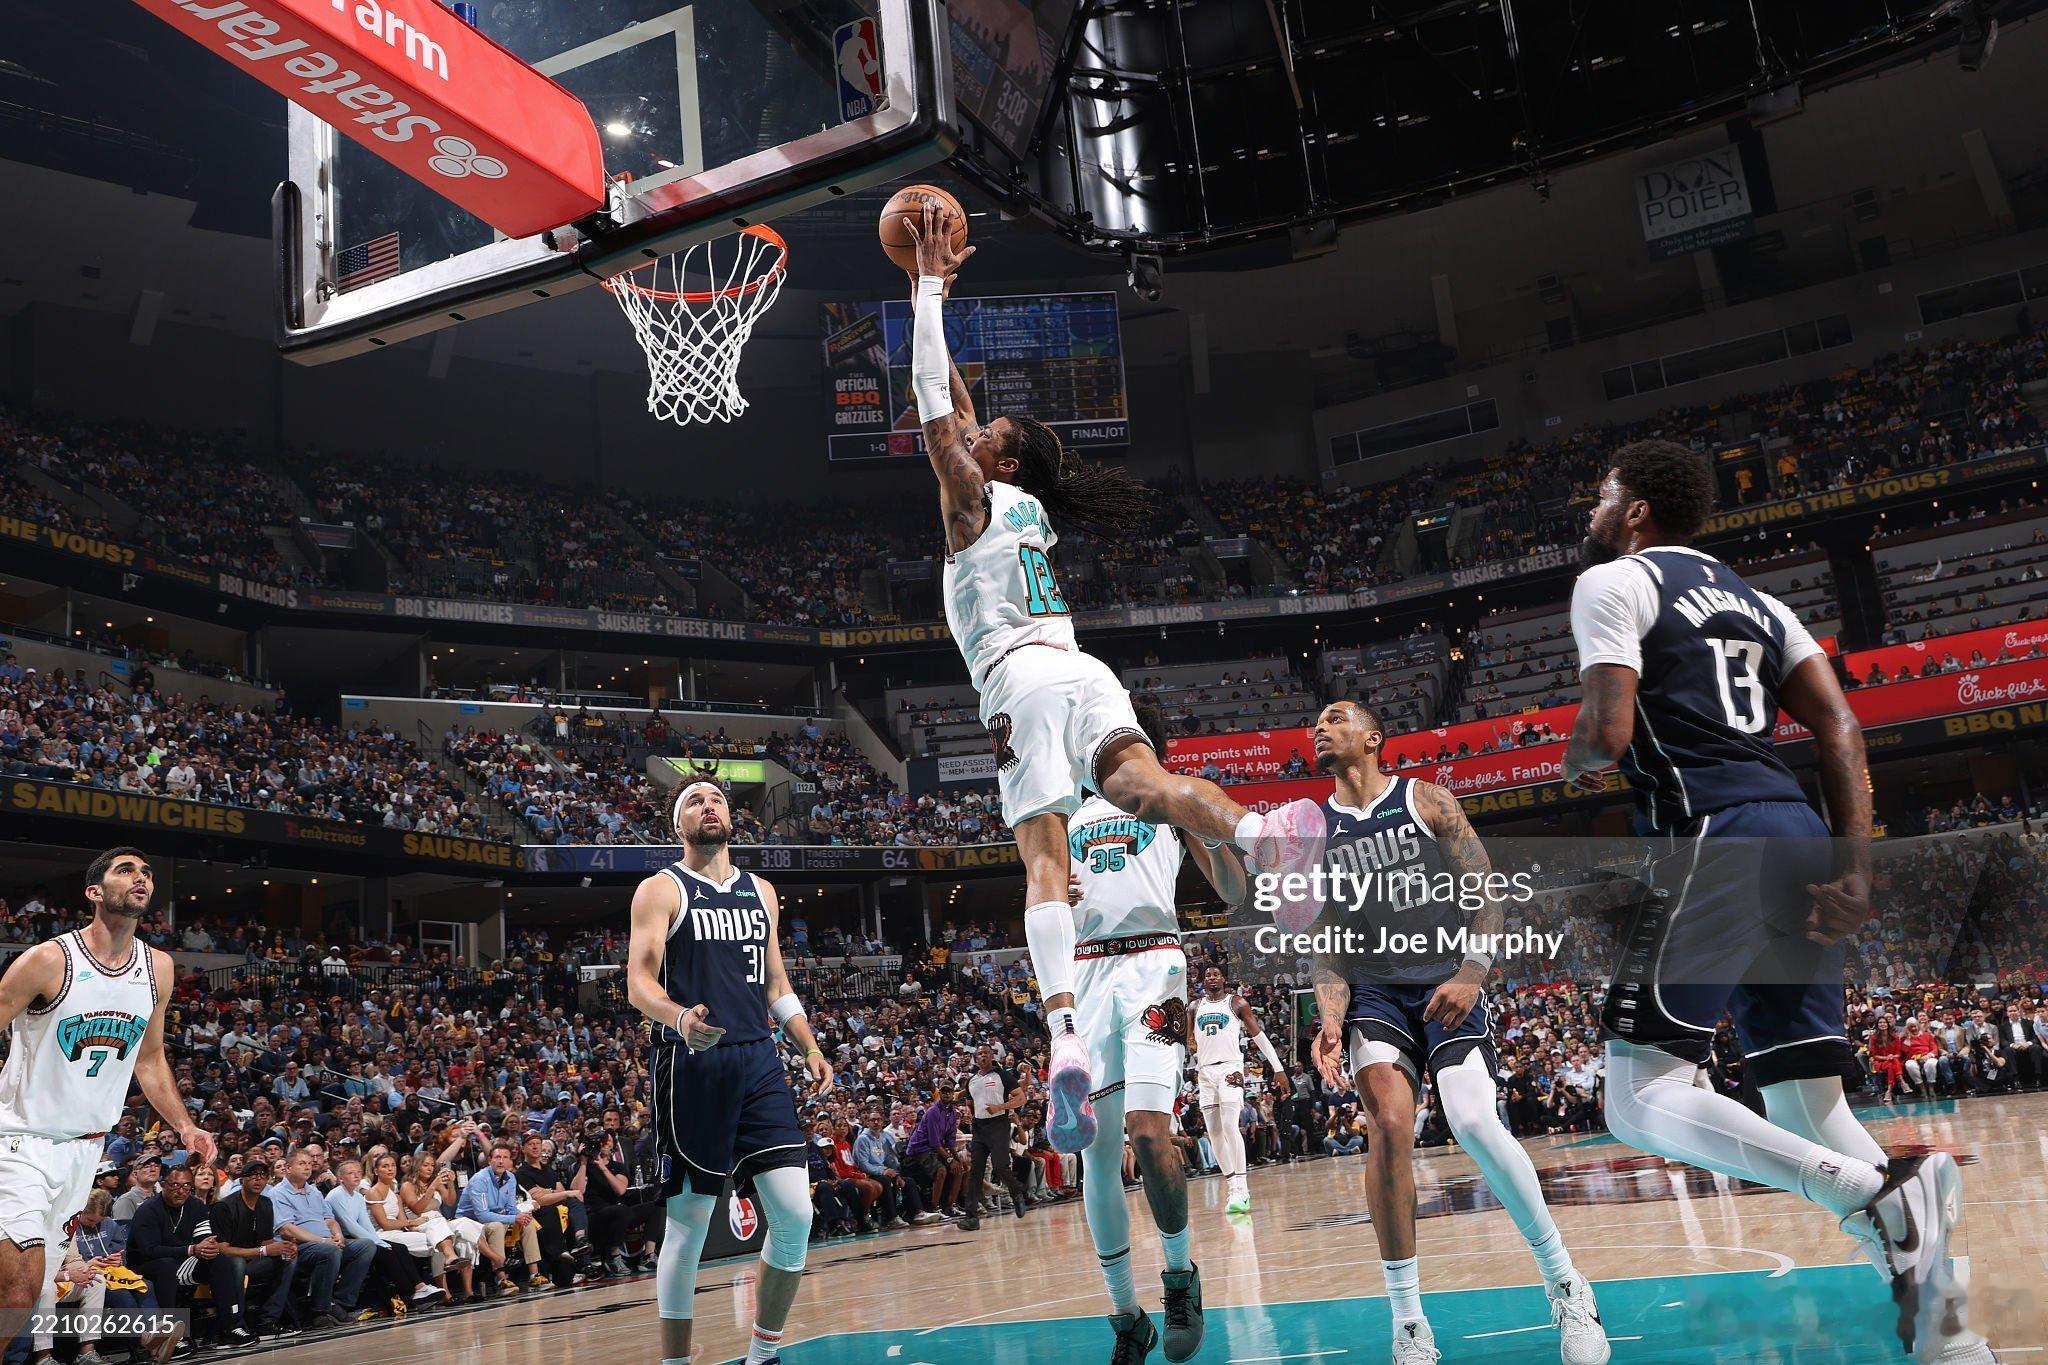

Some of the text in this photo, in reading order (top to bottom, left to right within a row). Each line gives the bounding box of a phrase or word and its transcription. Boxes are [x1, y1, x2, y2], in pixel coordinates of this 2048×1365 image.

[171, 0, 441, 143] StateFar
[846, 97, 868, 119] NBA
[996, 79, 1028, 127] 3:08
[835, 377, 879, 392] OFFICIAL
[835, 391, 881, 406] BBQ
[835, 410, 884, 425] GRIZZLIES
[1071, 427, 1126, 439] FINAL/OT
[869, 442, 887, 452] 1-0
[1804, 489, 1857, 513] THE
[1018, 542, 1071, 617] 12
[1450, 562, 1505, 588] SAUSAGE
[1518, 552, 1566, 575] CHEESE
[218, 573, 299, 609] BBQ NACHOS
[1278, 589, 1378, 615] BBQ SANDWICHES
[395, 597, 514, 624] BBQ SANDWICHES
[1129, 608, 1154, 626] BBQ
[1156, 604, 1204, 624] NACHOS
[597, 612, 747, 641] SAUSAGE + CHEESE PLATE
[819, 623, 926, 650] ENJOYING
[1704, 637, 1768, 736] 13
[1943, 709, 2016, 738] BBQ
[938, 760, 961, 770] NEED
[1202, 748, 1241, 763] points
[1243, 744, 1271, 757] with
[948, 768, 965, 776] MEM
[1256, 762, 1281, 774] App
[797, 783, 816, 793] 112A
[11, 781, 246, 835] SANDWICHES
[1376, 806, 1404, 820] chime
[1463, 788, 1536, 817] SAGE
[1540, 787, 1558, 804] &
[402, 833, 512, 868] SAUSAGE
[590, 850, 615, 870] 41
[760, 849, 792, 868] 3:08
[881, 849, 910, 869] 64
[1090, 846, 1126, 874] 35
[735, 888, 757, 899] chime
[1385, 863, 1434, 913] 25
[742, 944, 765, 985] 31
[84, 1010, 134, 1021] VANCOUVER
[57, 1013, 148, 1062] GRIZZLIES
[1206, 1025, 1218, 1036] 13
[86, 1050, 108, 1078] 7
